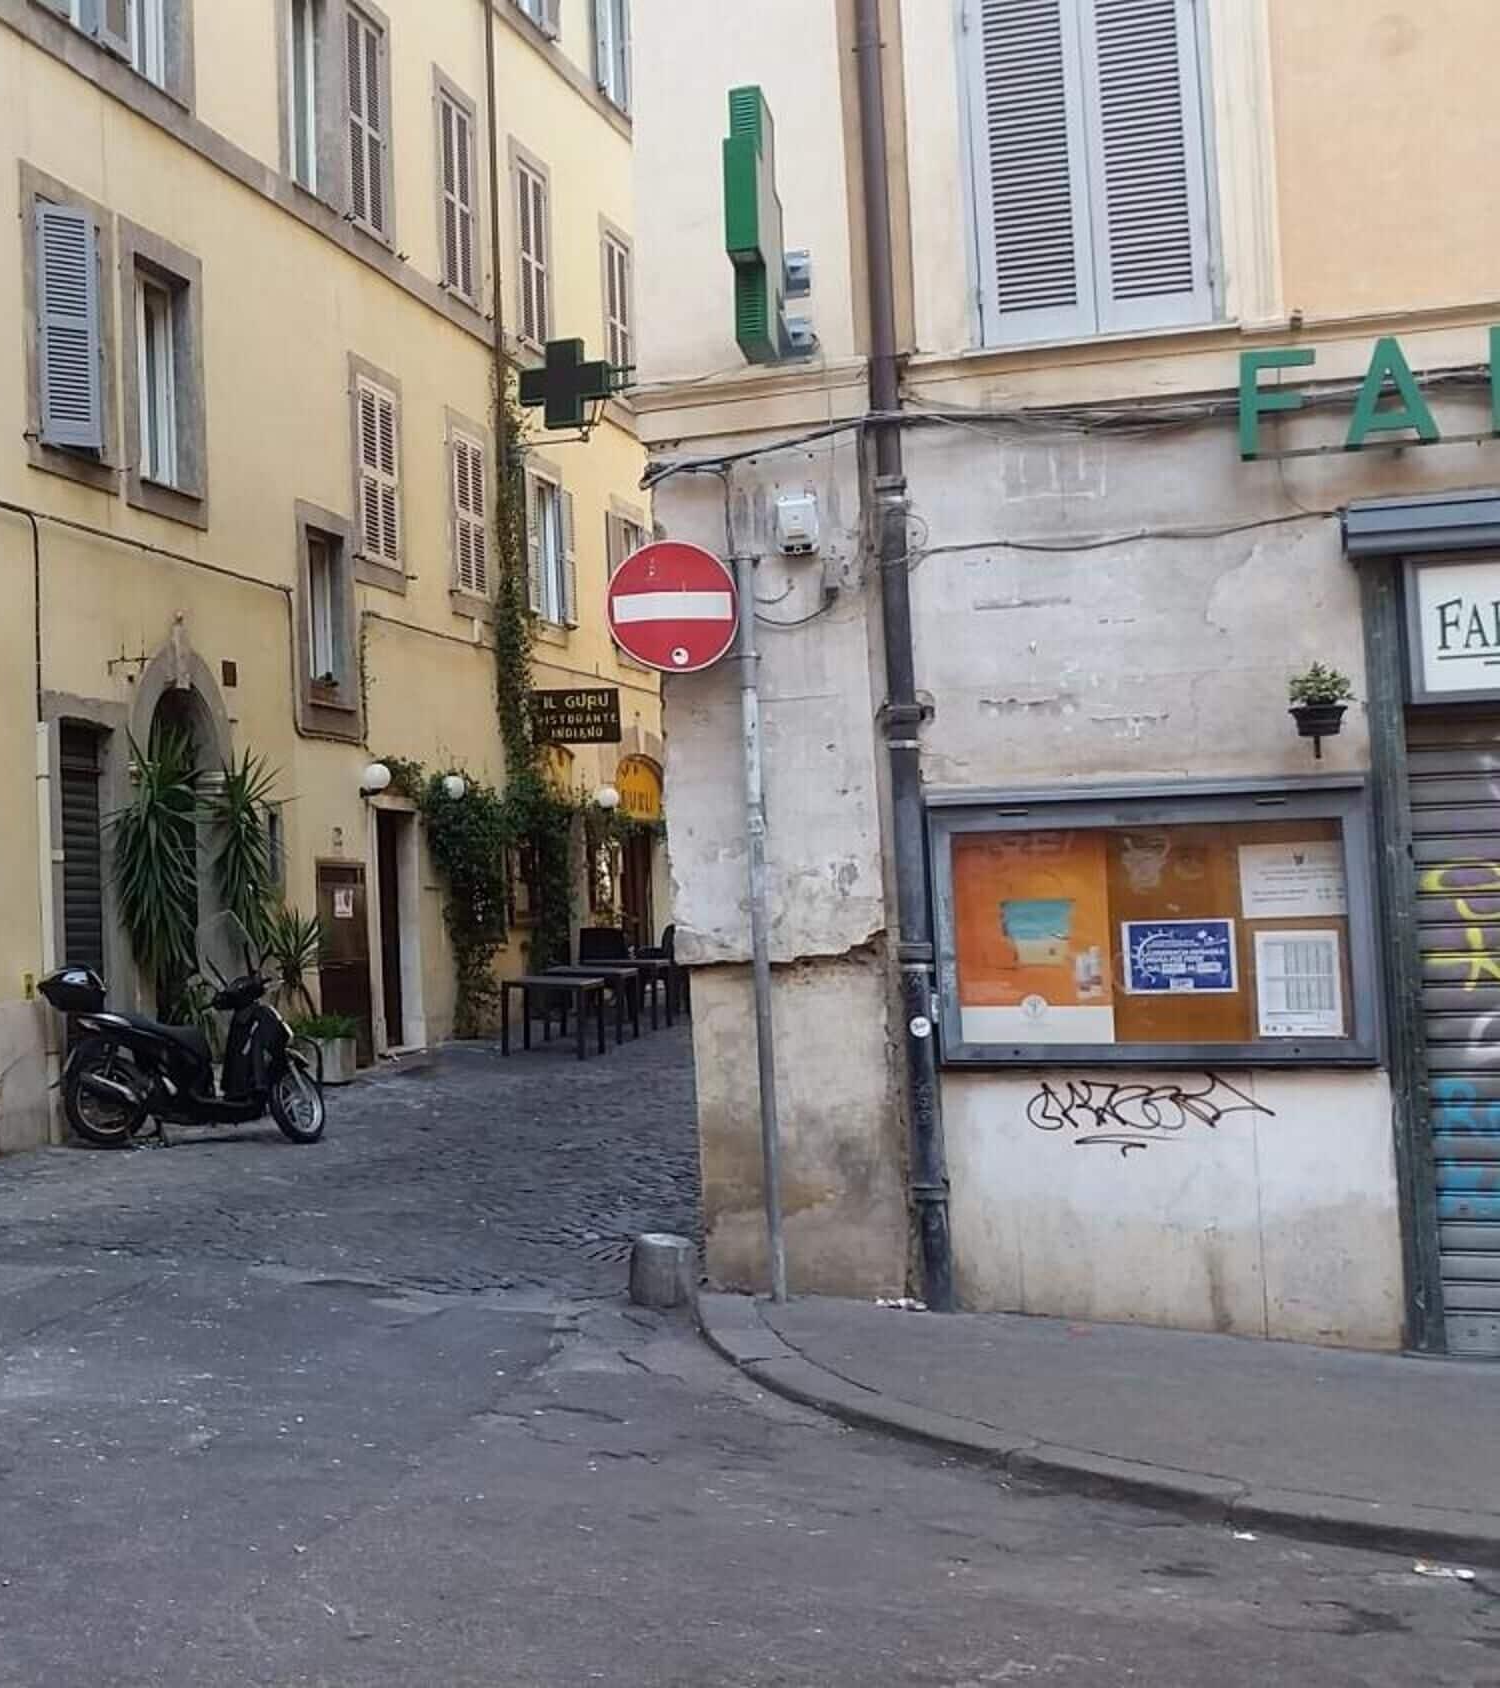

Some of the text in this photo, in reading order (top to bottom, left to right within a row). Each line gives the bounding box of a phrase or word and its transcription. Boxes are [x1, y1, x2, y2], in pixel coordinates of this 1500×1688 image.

[1238, 326, 1500, 462] FA
[543, 691, 609, 711] IL GURU
